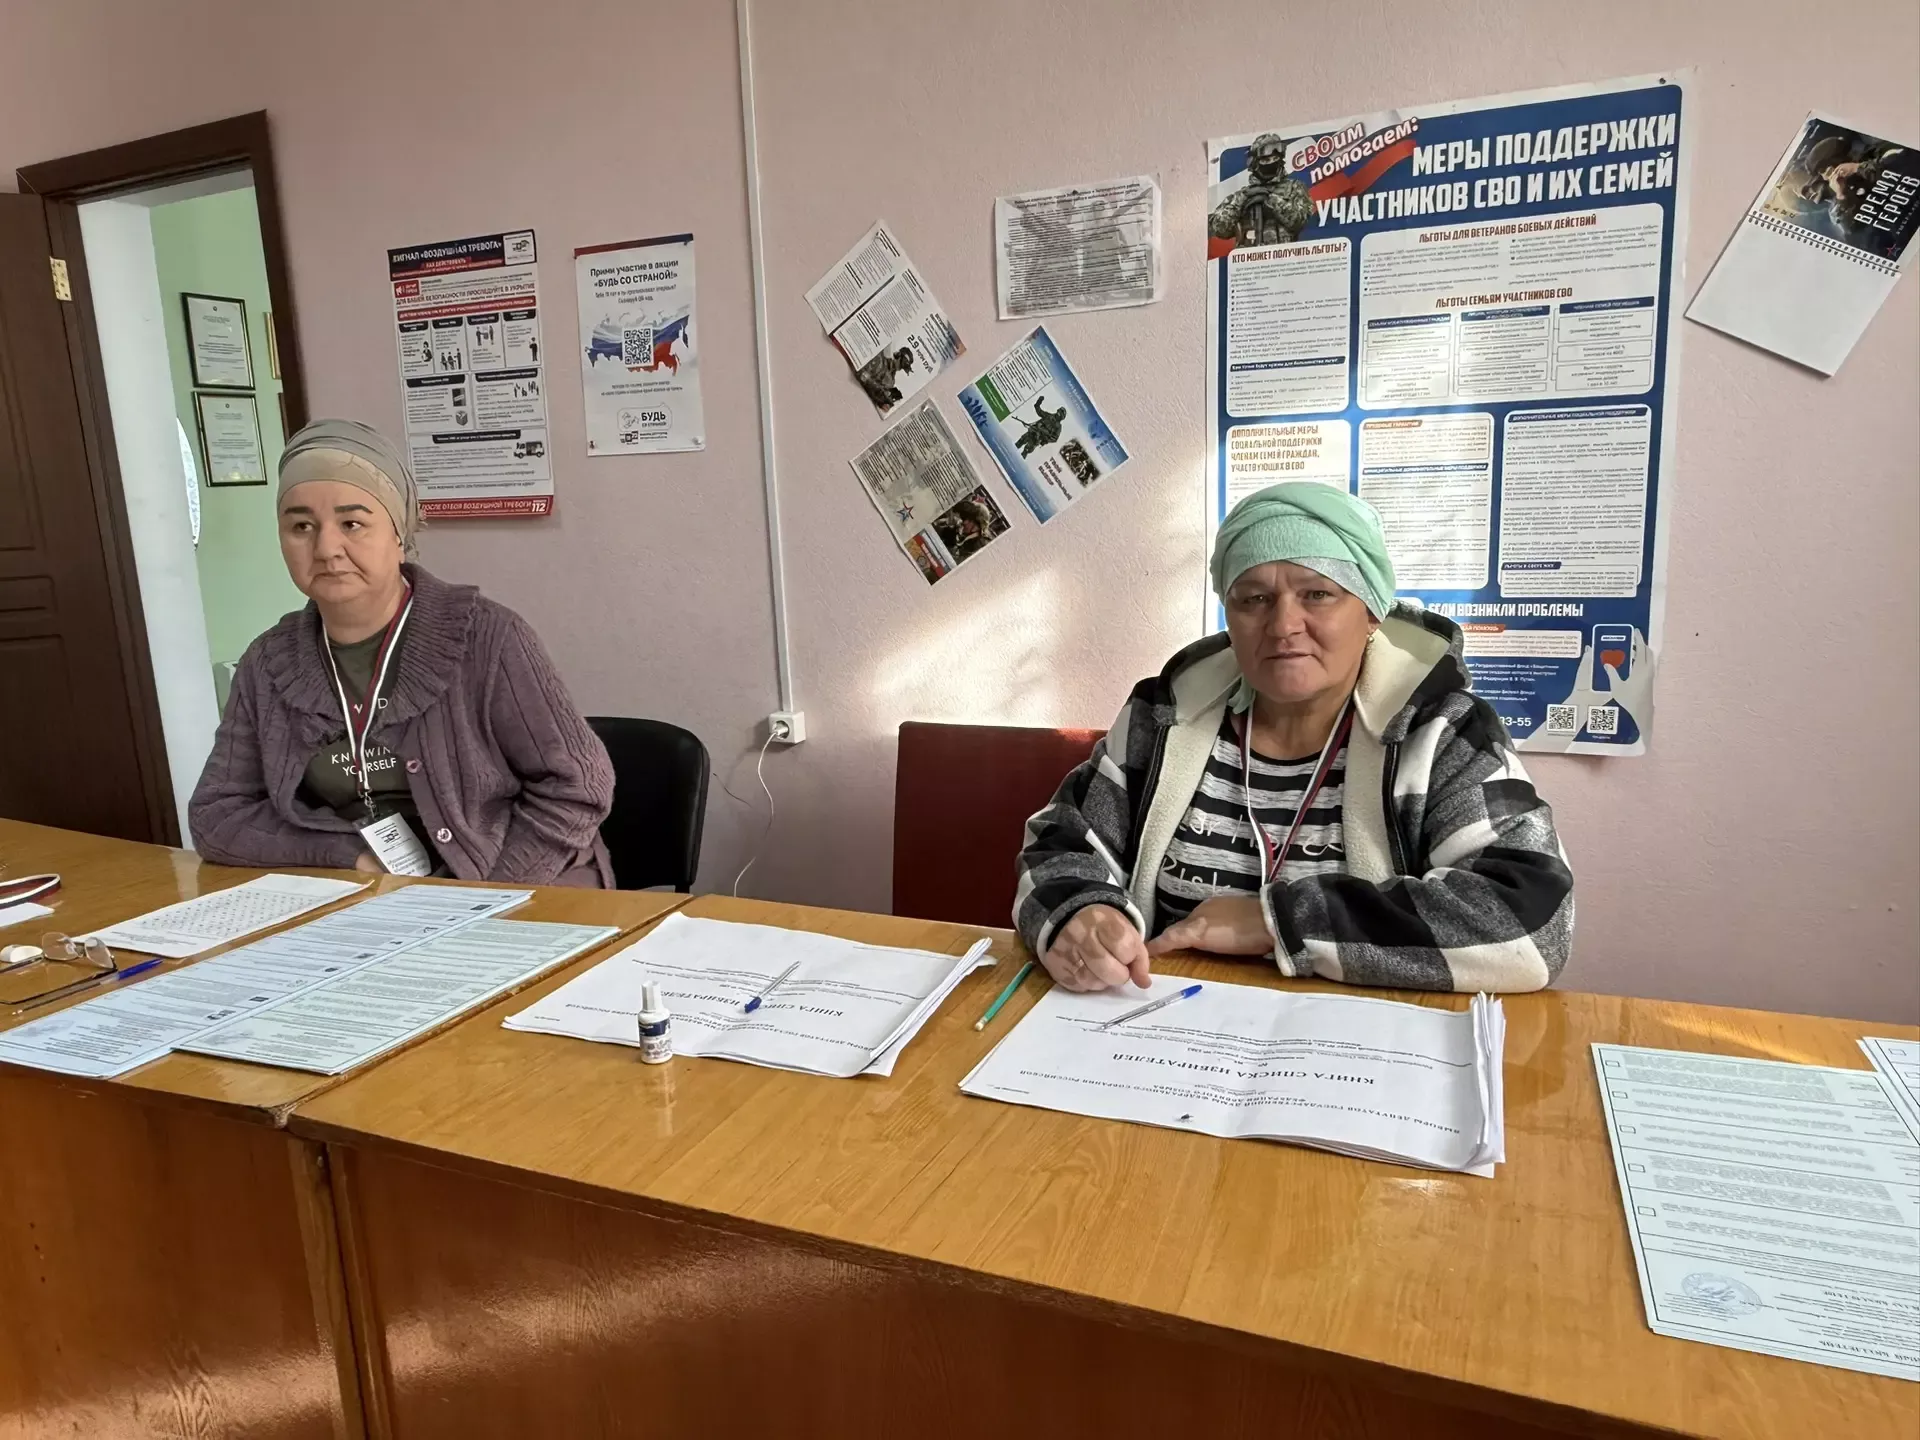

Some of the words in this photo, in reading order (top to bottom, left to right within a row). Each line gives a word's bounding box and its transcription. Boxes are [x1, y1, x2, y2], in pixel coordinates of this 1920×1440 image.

[1310, 116, 1419, 184] помогаем:
[1412, 137, 1490, 177] МЕРЫ
[1495, 113, 1676, 167] ПОДДЕРЖКИ
[1315, 181, 1468, 227] УЧАСТНИКОВ
[1474, 175, 1521, 208] СВО
[1527, 172, 1544, 203] И
[1549, 167, 1583, 200] ИХ
[1588, 151, 1674, 196] СЕМЕЙ
[1853, 169, 1902, 226] ВРЕМЯ
[1872, 174, 1920, 232] ГЕРОЕВ
[1418, 231, 1451, 243] ЛЬГОТЫ
[1452, 229, 1470, 240] ДЛЯ
[1470, 224, 1516, 239] ВЕТЕРАНОВ
[1518, 219, 1552, 233] БОЕВЫХ
[1553, 213, 1597, 230] ДЕЙСТВИЙ
[1232, 254, 1246, 263] КТО
[1246, 251, 1272, 262] МОЖЕТ
[1273, 247, 1311, 259] ПОЛУЧИТЬ
[1311, 243, 1342, 255] ЛЬГОТЫ
[590, 267, 615, 278] Прими
[616, 263, 647, 275] участие
[655, 260, 679, 269] акции
[594, 278, 619, 288] «БУДЬ
[619, 276, 632, 285] СО
[633, 269, 678, 284] СТРАНОЙ!»
[1435, 297, 1468, 308] ЛЬГОТЫ
[1469, 293, 1502, 306] СЕМЬЯМ
[1502, 289, 1555, 304] УЧАСТНИКОВ
[1556, 287, 1573, 298] СВО
[641, 411, 666, 421] БУДЬ
[1231, 426, 1296, 438] ДОПОЛНИТЕЛЬНЫЕ
[1297, 425, 1319, 435] МЕРЫ
[1231, 438, 1276, 450] СОЦИАЛЬНОЙ
[1277, 437, 1322, 448] ПОДДЕРЖКИ
[1231, 451, 1259, 461] ЧЛЕНАМ
[1259, 449, 1281, 460] СЕМЕЙ
[1231, 461, 1285, 472] УЧАСТВУЮЩИХ
[1285, 461, 1290, 470] В
[1291, 460, 1305, 470] СВО
[531, 503, 546, 512] 112
[1457, 603, 1515, 617] ВОЗНИКЛИ
[1518, 603, 1583, 616] ПРОБЛЕМЫ
[342, 758, 397, 776] YORSELF
[564, 1003, 610, 1014] РОССИЙСКОЙ
[759, 1003, 796, 1011] СПИС
[799, 1005, 843, 1017] КНИГА
[1112, 1053, 1231, 1075] ИЗБИРАТЕЛЕЙ
[1019, 1070, 1080, 1083] РОССИЙСКОЙ
[1236, 1071, 1307, 1079] СПИСКА
[1313, 1072, 1374, 1085] КНИГА
[1082, 1078, 1131, 1089] СОБРАНИЯ
[1133, 1086, 1210, 1100] ФЕДЕРАЛЬНОГО
[1211, 1098, 1241, 1107] ДУМЫ
[1244, 1100, 1344, 1110] ГОСУДАРСТВЕННОЙ
[1347, 1107, 1411, 1121] ДЕПУТАТОВ
[1413, 1118, 1461, 1135] ВЫБОРЫ
